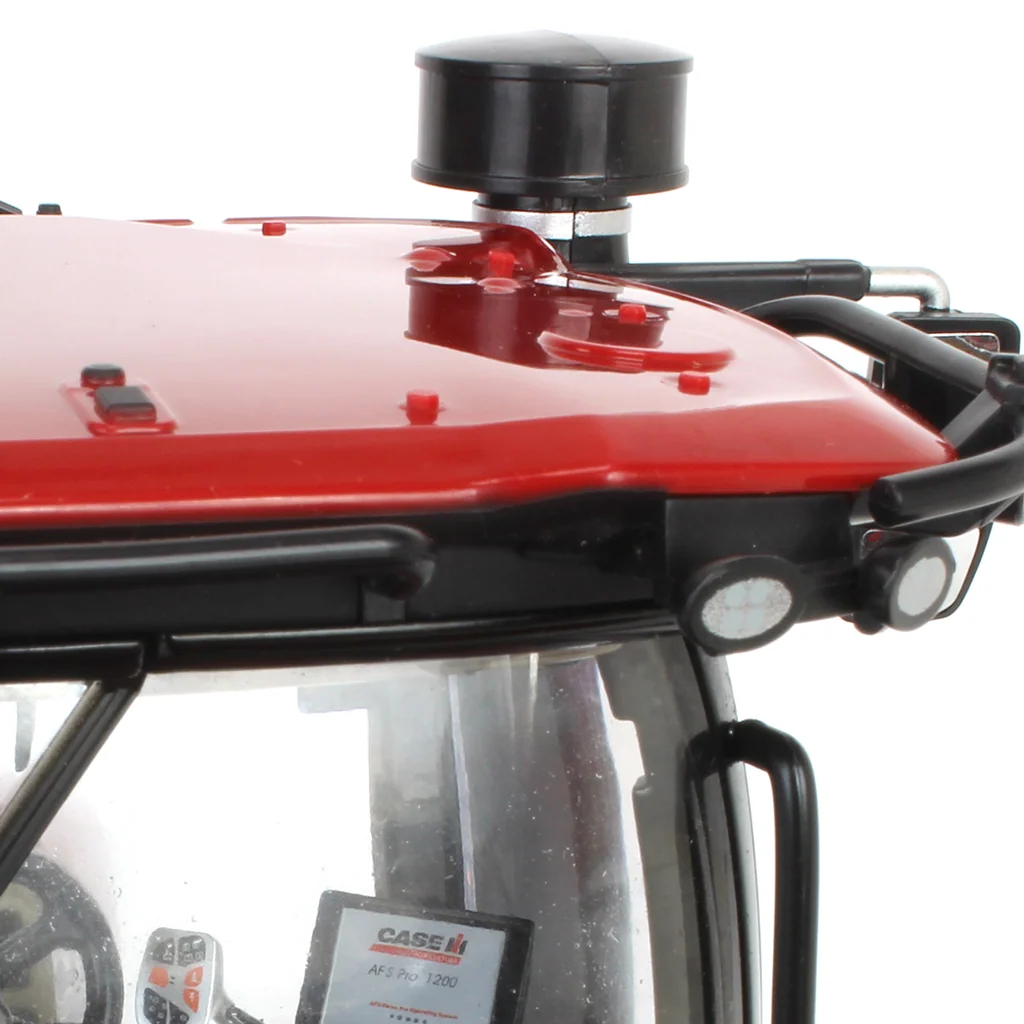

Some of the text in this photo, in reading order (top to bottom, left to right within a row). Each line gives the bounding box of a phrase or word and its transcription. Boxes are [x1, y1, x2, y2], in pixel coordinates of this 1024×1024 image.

[377, 927, 445, 951] CASE
[368, 964, 458, 988] AFS Pro 1200
